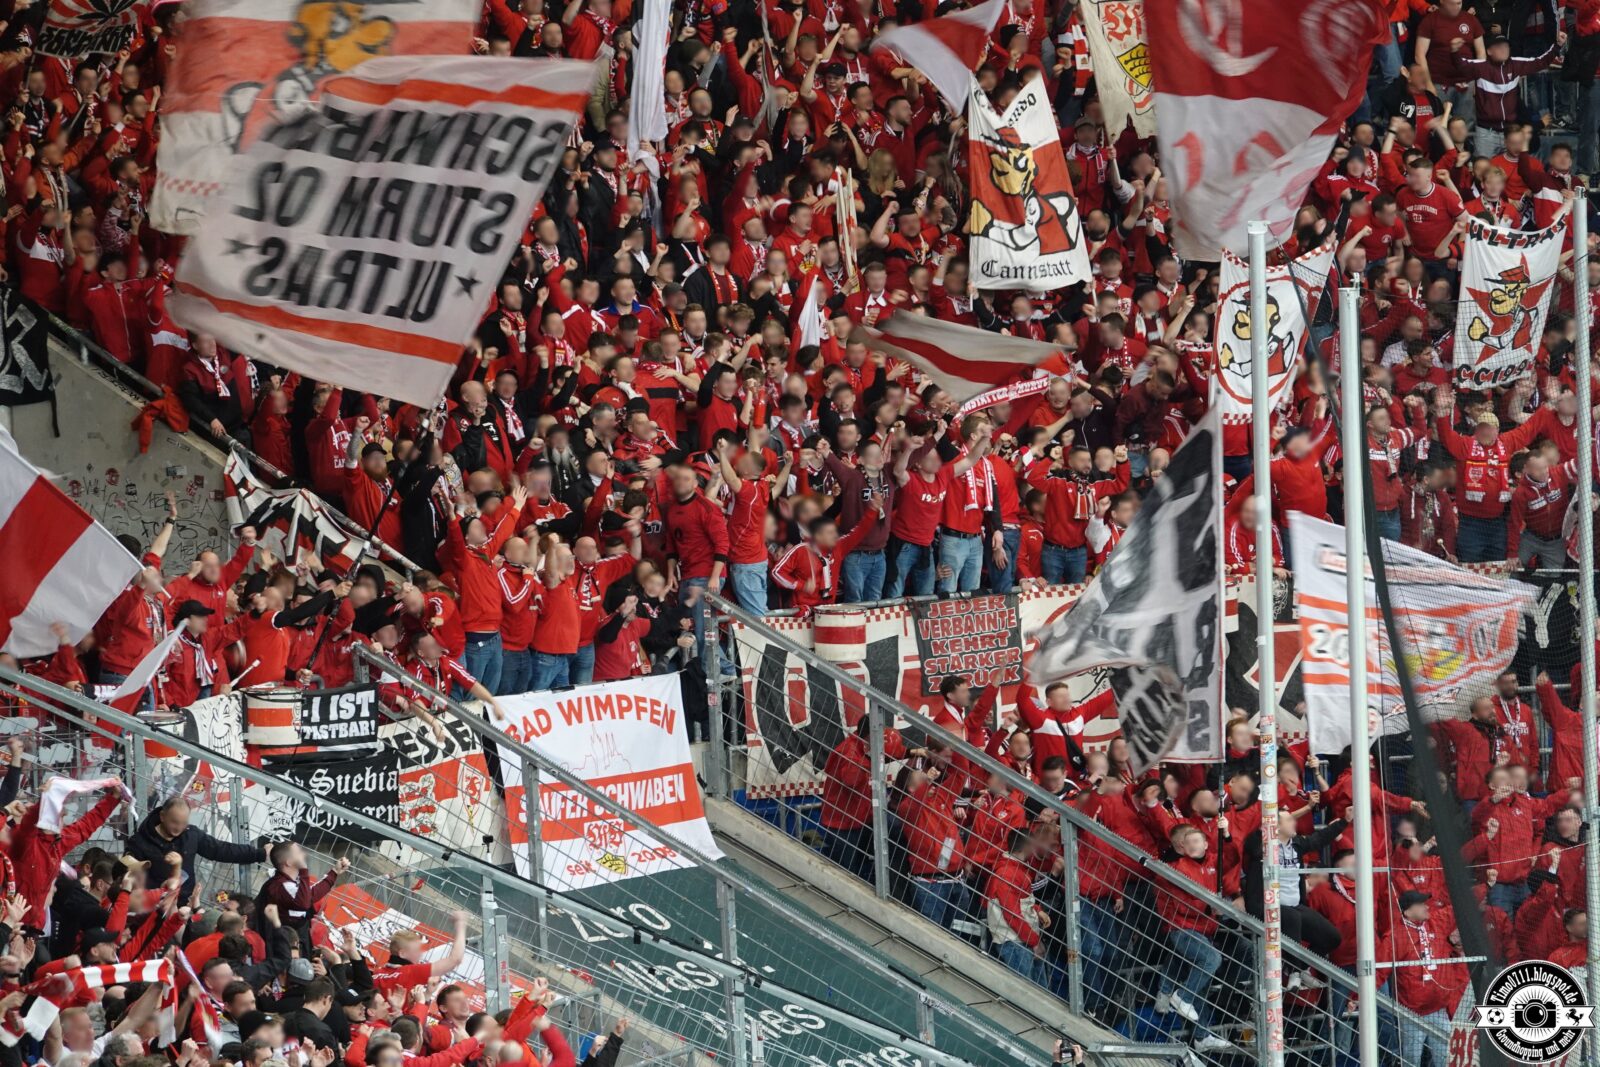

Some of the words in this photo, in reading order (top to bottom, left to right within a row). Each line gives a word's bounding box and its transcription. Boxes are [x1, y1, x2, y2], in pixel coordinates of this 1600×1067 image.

[1469, 213, 1567, 250] ULTRAS
[981, 257, 1074, 280] Cannstatt
[1457, 358, 1535, 386] CC199
[927, 595, 1007, 619] JEDER
[917, 607, 1018, 640] VERBANNTE
[930, 629, 1011, 656] KEHRT
[329, 689, 376, 721] IST
[504, 707, 553, 744] BAD
[556, 693, 677, 735] WIMPFEN
[301, 720, 376, 740] TASTBAR!
[308, 766, 400, 796] Suebia
[594, 772, 686, 816] SCHWABEN
